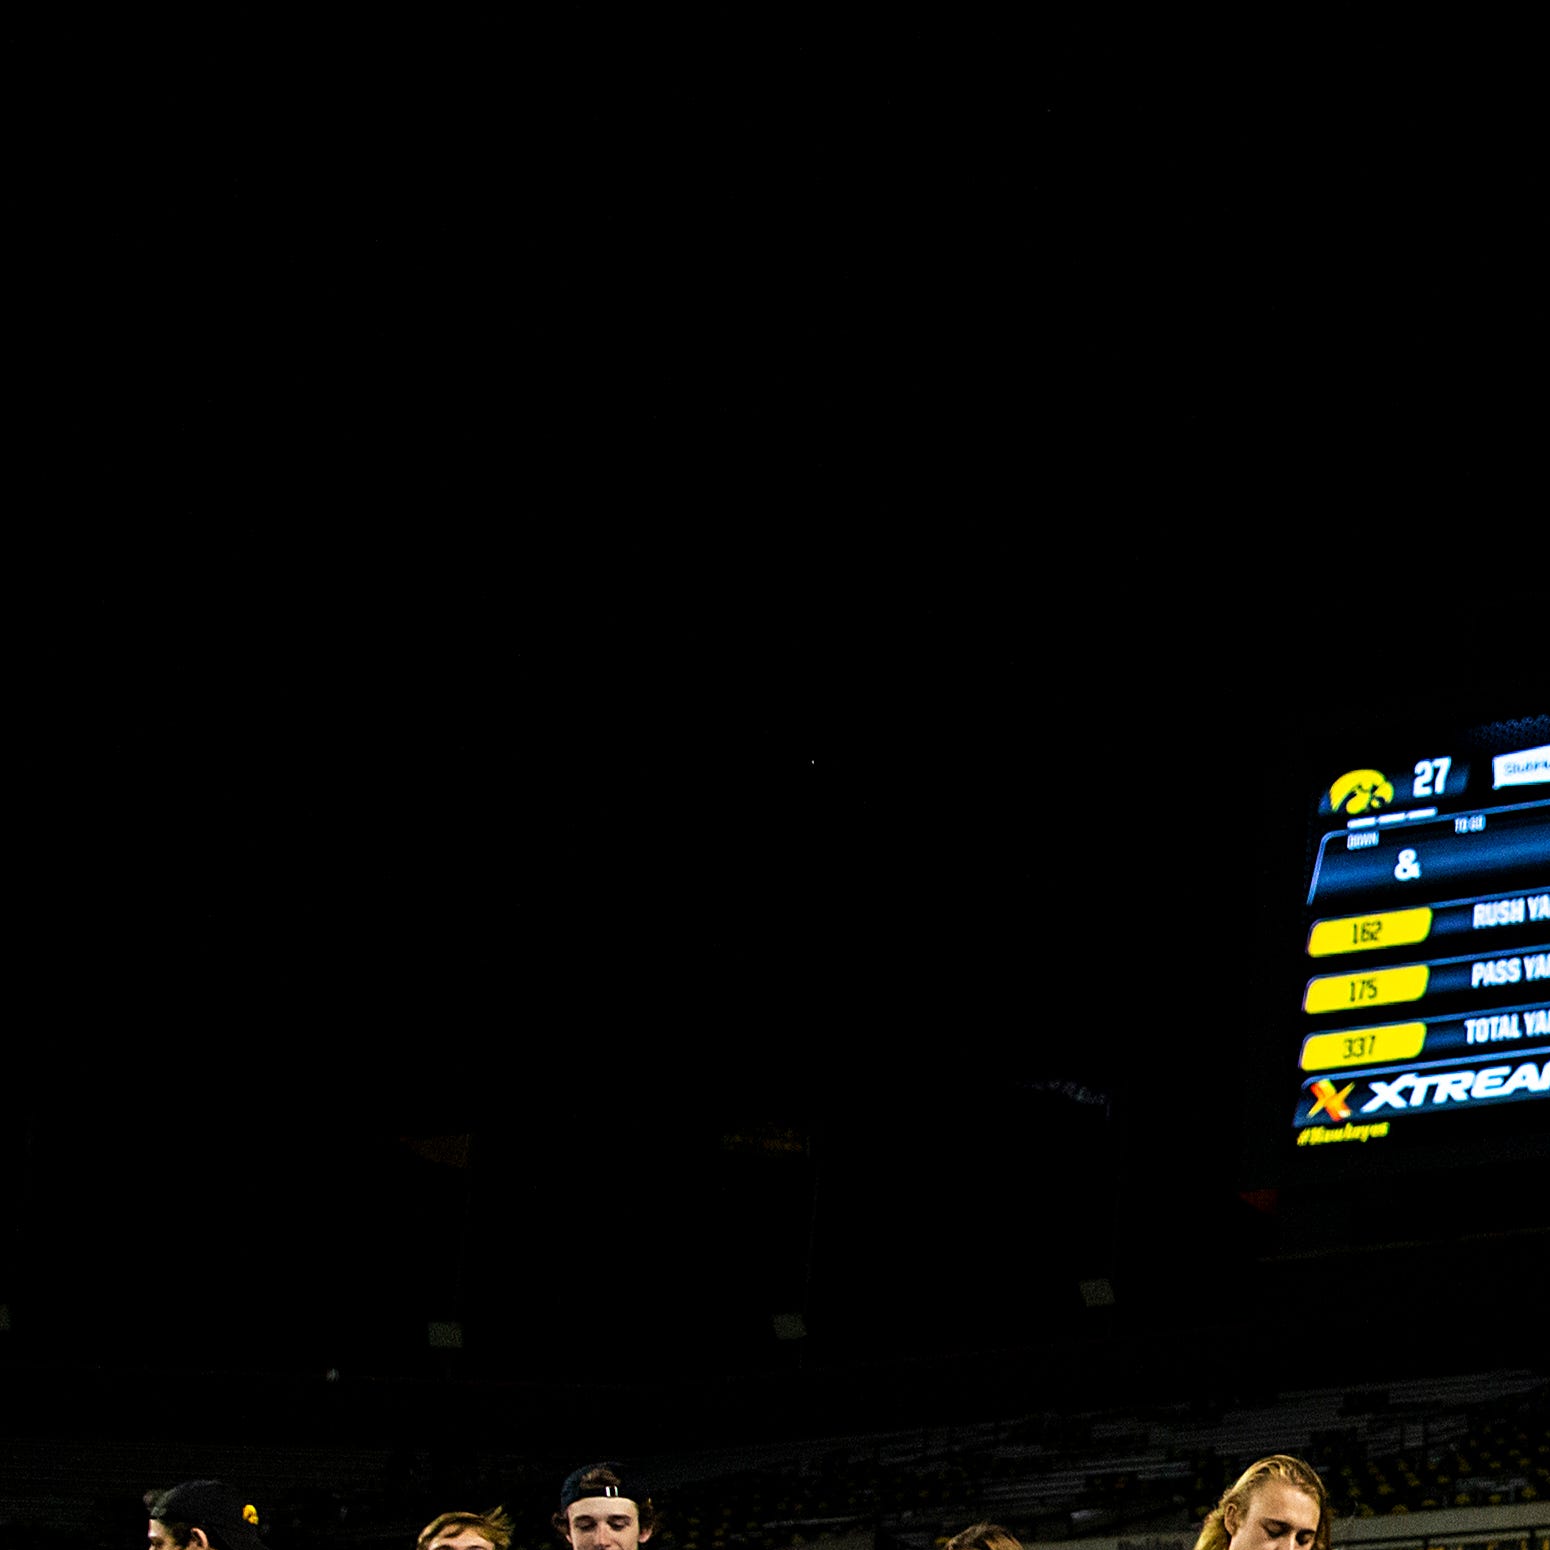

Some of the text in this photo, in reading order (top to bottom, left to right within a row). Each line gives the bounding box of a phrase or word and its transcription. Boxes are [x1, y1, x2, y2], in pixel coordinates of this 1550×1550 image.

[1413, 756, 1451, 797] 27
[1394, 848, 1421, 880] &
[1473, 893, 1524, 929] RUSH
[1351, 921, 1383, 944] 162
[1471, 955, 1522, 990] PASS
[1349, 979, 1380, 1003] 175
[1465, 1013, 1521, 1045] TOTAL
[1343, 1036, 1377, 1060] 337
